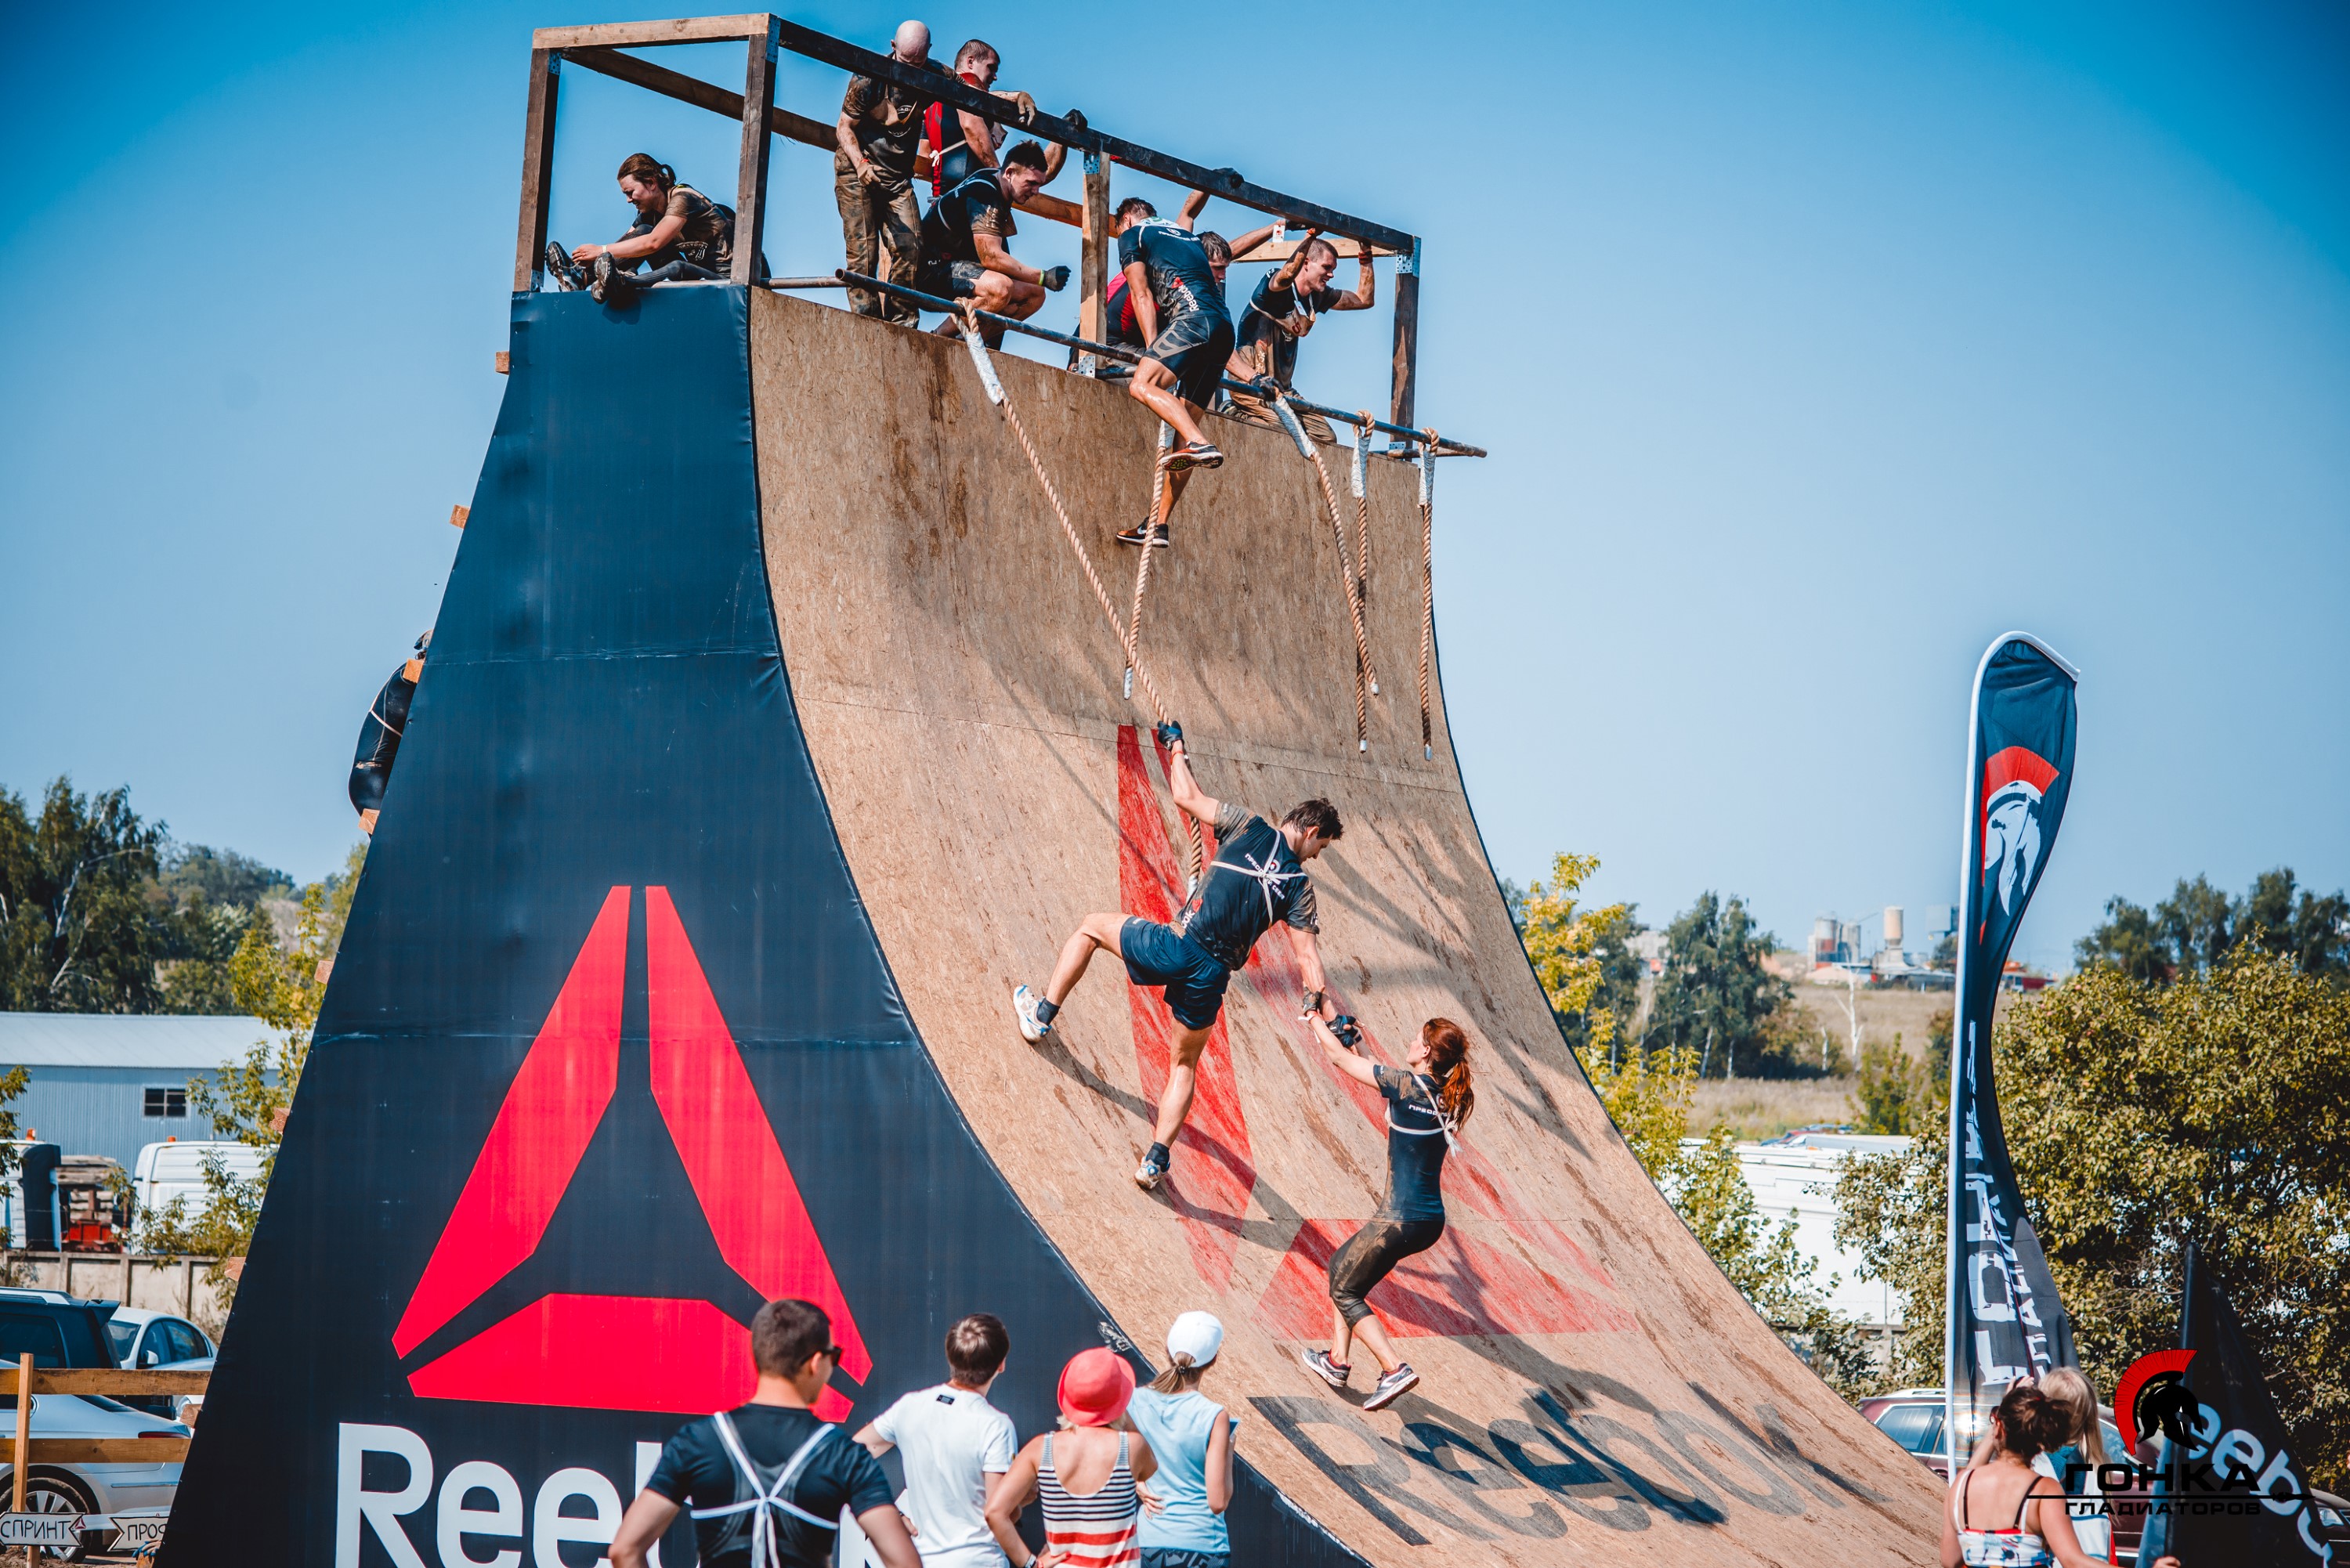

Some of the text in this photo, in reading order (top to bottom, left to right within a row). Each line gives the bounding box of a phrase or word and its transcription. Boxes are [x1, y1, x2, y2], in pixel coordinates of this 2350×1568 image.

[1178, 284, 1199, 312] Reebok
[1245, 853, 1272, 887] ПРЕОДЙ
[1247, 1381, 1889, 1547] Reebok
[1, 1519, 71, 1540] СПРИНТ
